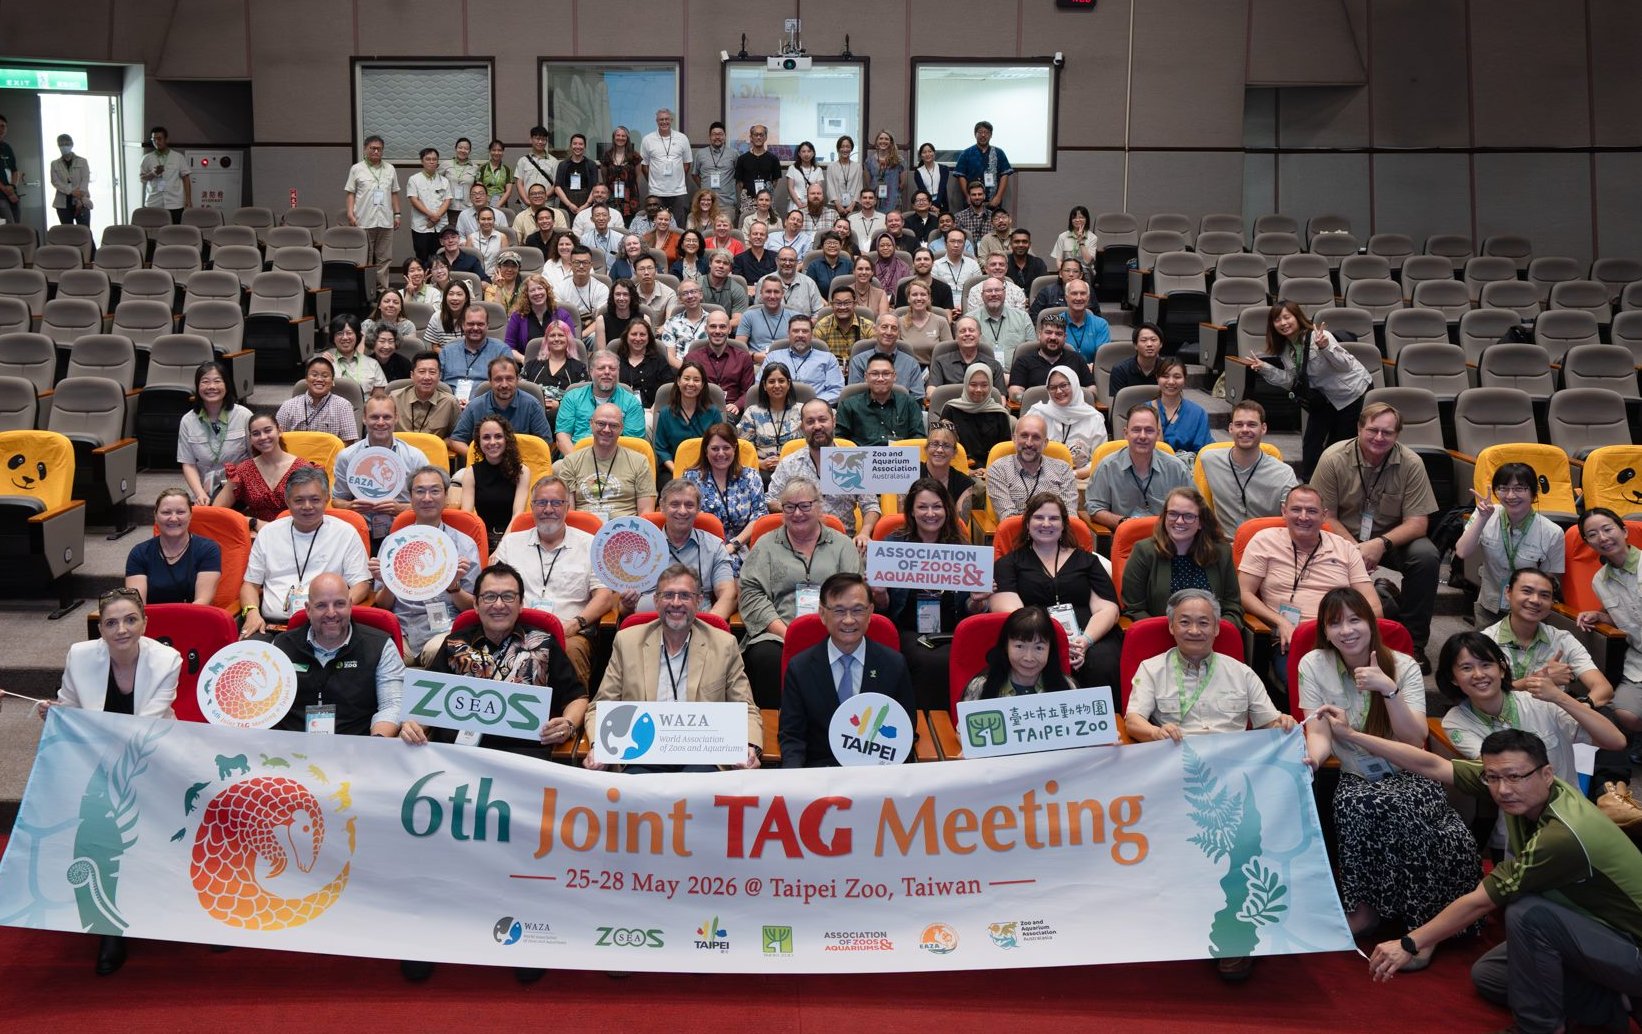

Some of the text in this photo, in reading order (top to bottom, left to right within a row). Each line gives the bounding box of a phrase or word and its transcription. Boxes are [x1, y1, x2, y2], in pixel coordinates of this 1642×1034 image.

[348, 476, 373, 487] EAZA
[875, 547, 976, 561] ASSOCIATION
[874, 571, 960, 585] AQUARIUMS
[898, 560, 985, 587] OF ZOOS &
[409, 680, 542, 731] ZOOS
[455, 696, 496, 714] SEA
[1009, 700, 1107, 726] 臺北市立動物園
[659, 714, 710, 727] WAZA
[659, 744, 667, 752] of
[703, 744, 744, 753] Aquariums
[841, 734, 896, 761] TAIPEI
[400, 770, 1150, 865] 6th Joint TAG Meeting
[565, 869, 982, 904] 25-28 May 2026 @ Taipei Zoo, Taiwan
[524, 922, 551, 931] WAZA
[595, 927, 664, 948] ZOOS
[618, 934, 641, 942] SEA
[880, 939, 893, 950] &
[694, 941, 729, 950] TAIPEI
